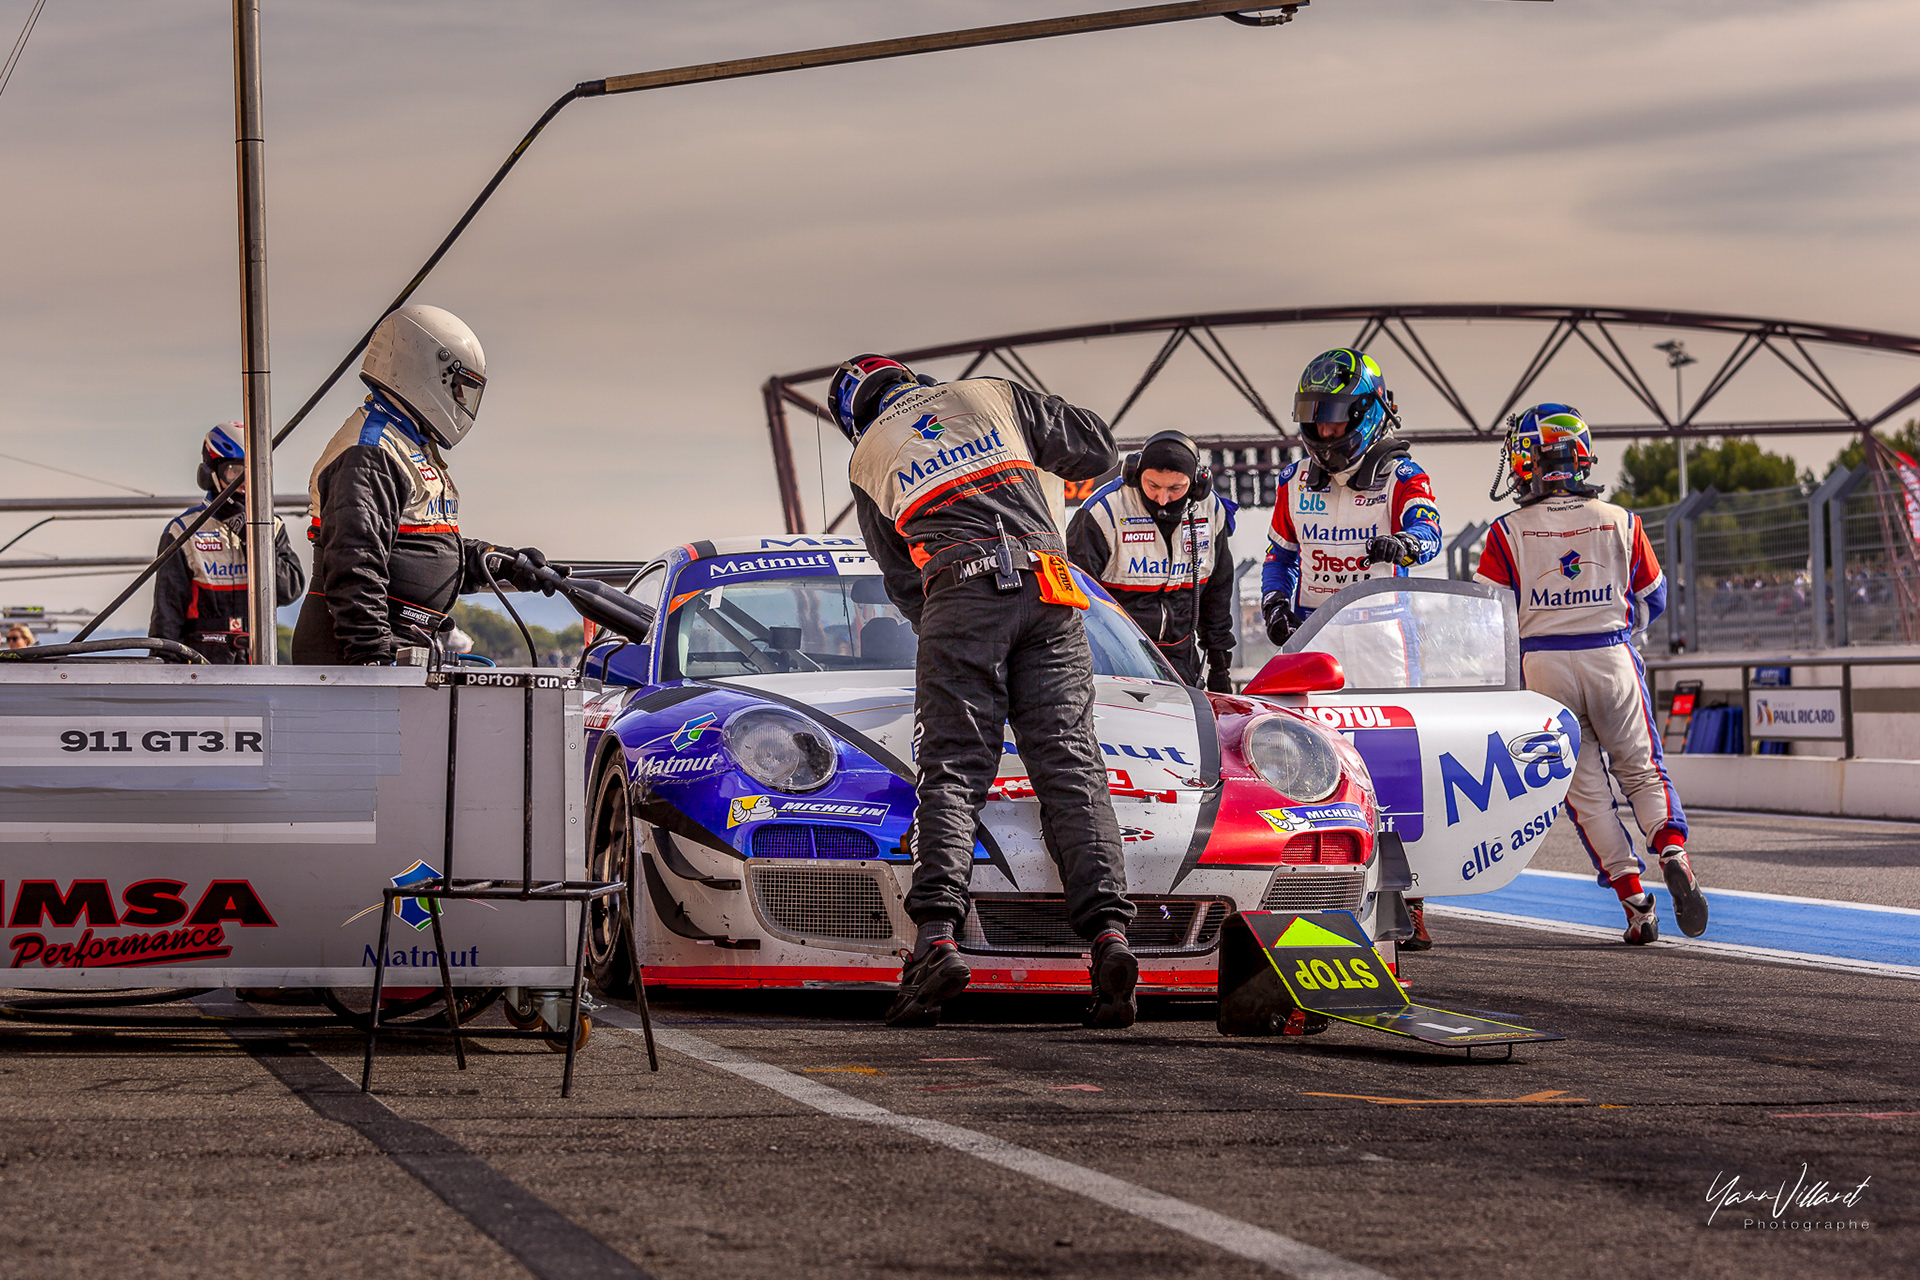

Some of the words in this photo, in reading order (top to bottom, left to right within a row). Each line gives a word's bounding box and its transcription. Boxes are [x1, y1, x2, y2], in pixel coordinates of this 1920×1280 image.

[879, 389, 948, 425] Performance
[893, 394, 923, 410] IMSA
[897, 428, 1005, 492] Matmut
[1299, 493, 1326, 511] blb
[1124, 532, 1155, 541] MOTUL
[1302, 523, 1378, 541] Matmut
[1523, 525, 1615, 538] PORSCHE
[760, 537, 867, 549] Ma
[710, 553, 829, 576] Matmut
[1313, 574, 1372, 583] POWER
[704, 585, 724, 610] 1
[1530, 583, 1612, 607] Matmut
[1798, 709, 1835, 723] RICARD
[60, 731, 133, 752] 911
[142, 731, 224, 752] GT3
[235, 732, 263, 752] R
[631, 753, 718, 778] Matmut
[781, 801, 886, 817] MICHELIN
[1305, 808, 1365, 821] MICHELIN
[1462, 840, 1504, 881] elle
[0, 879, 277, 927] MSA
[10, 925, 225, 968] Performance
[1295, 958, 1380, 990] STOP
